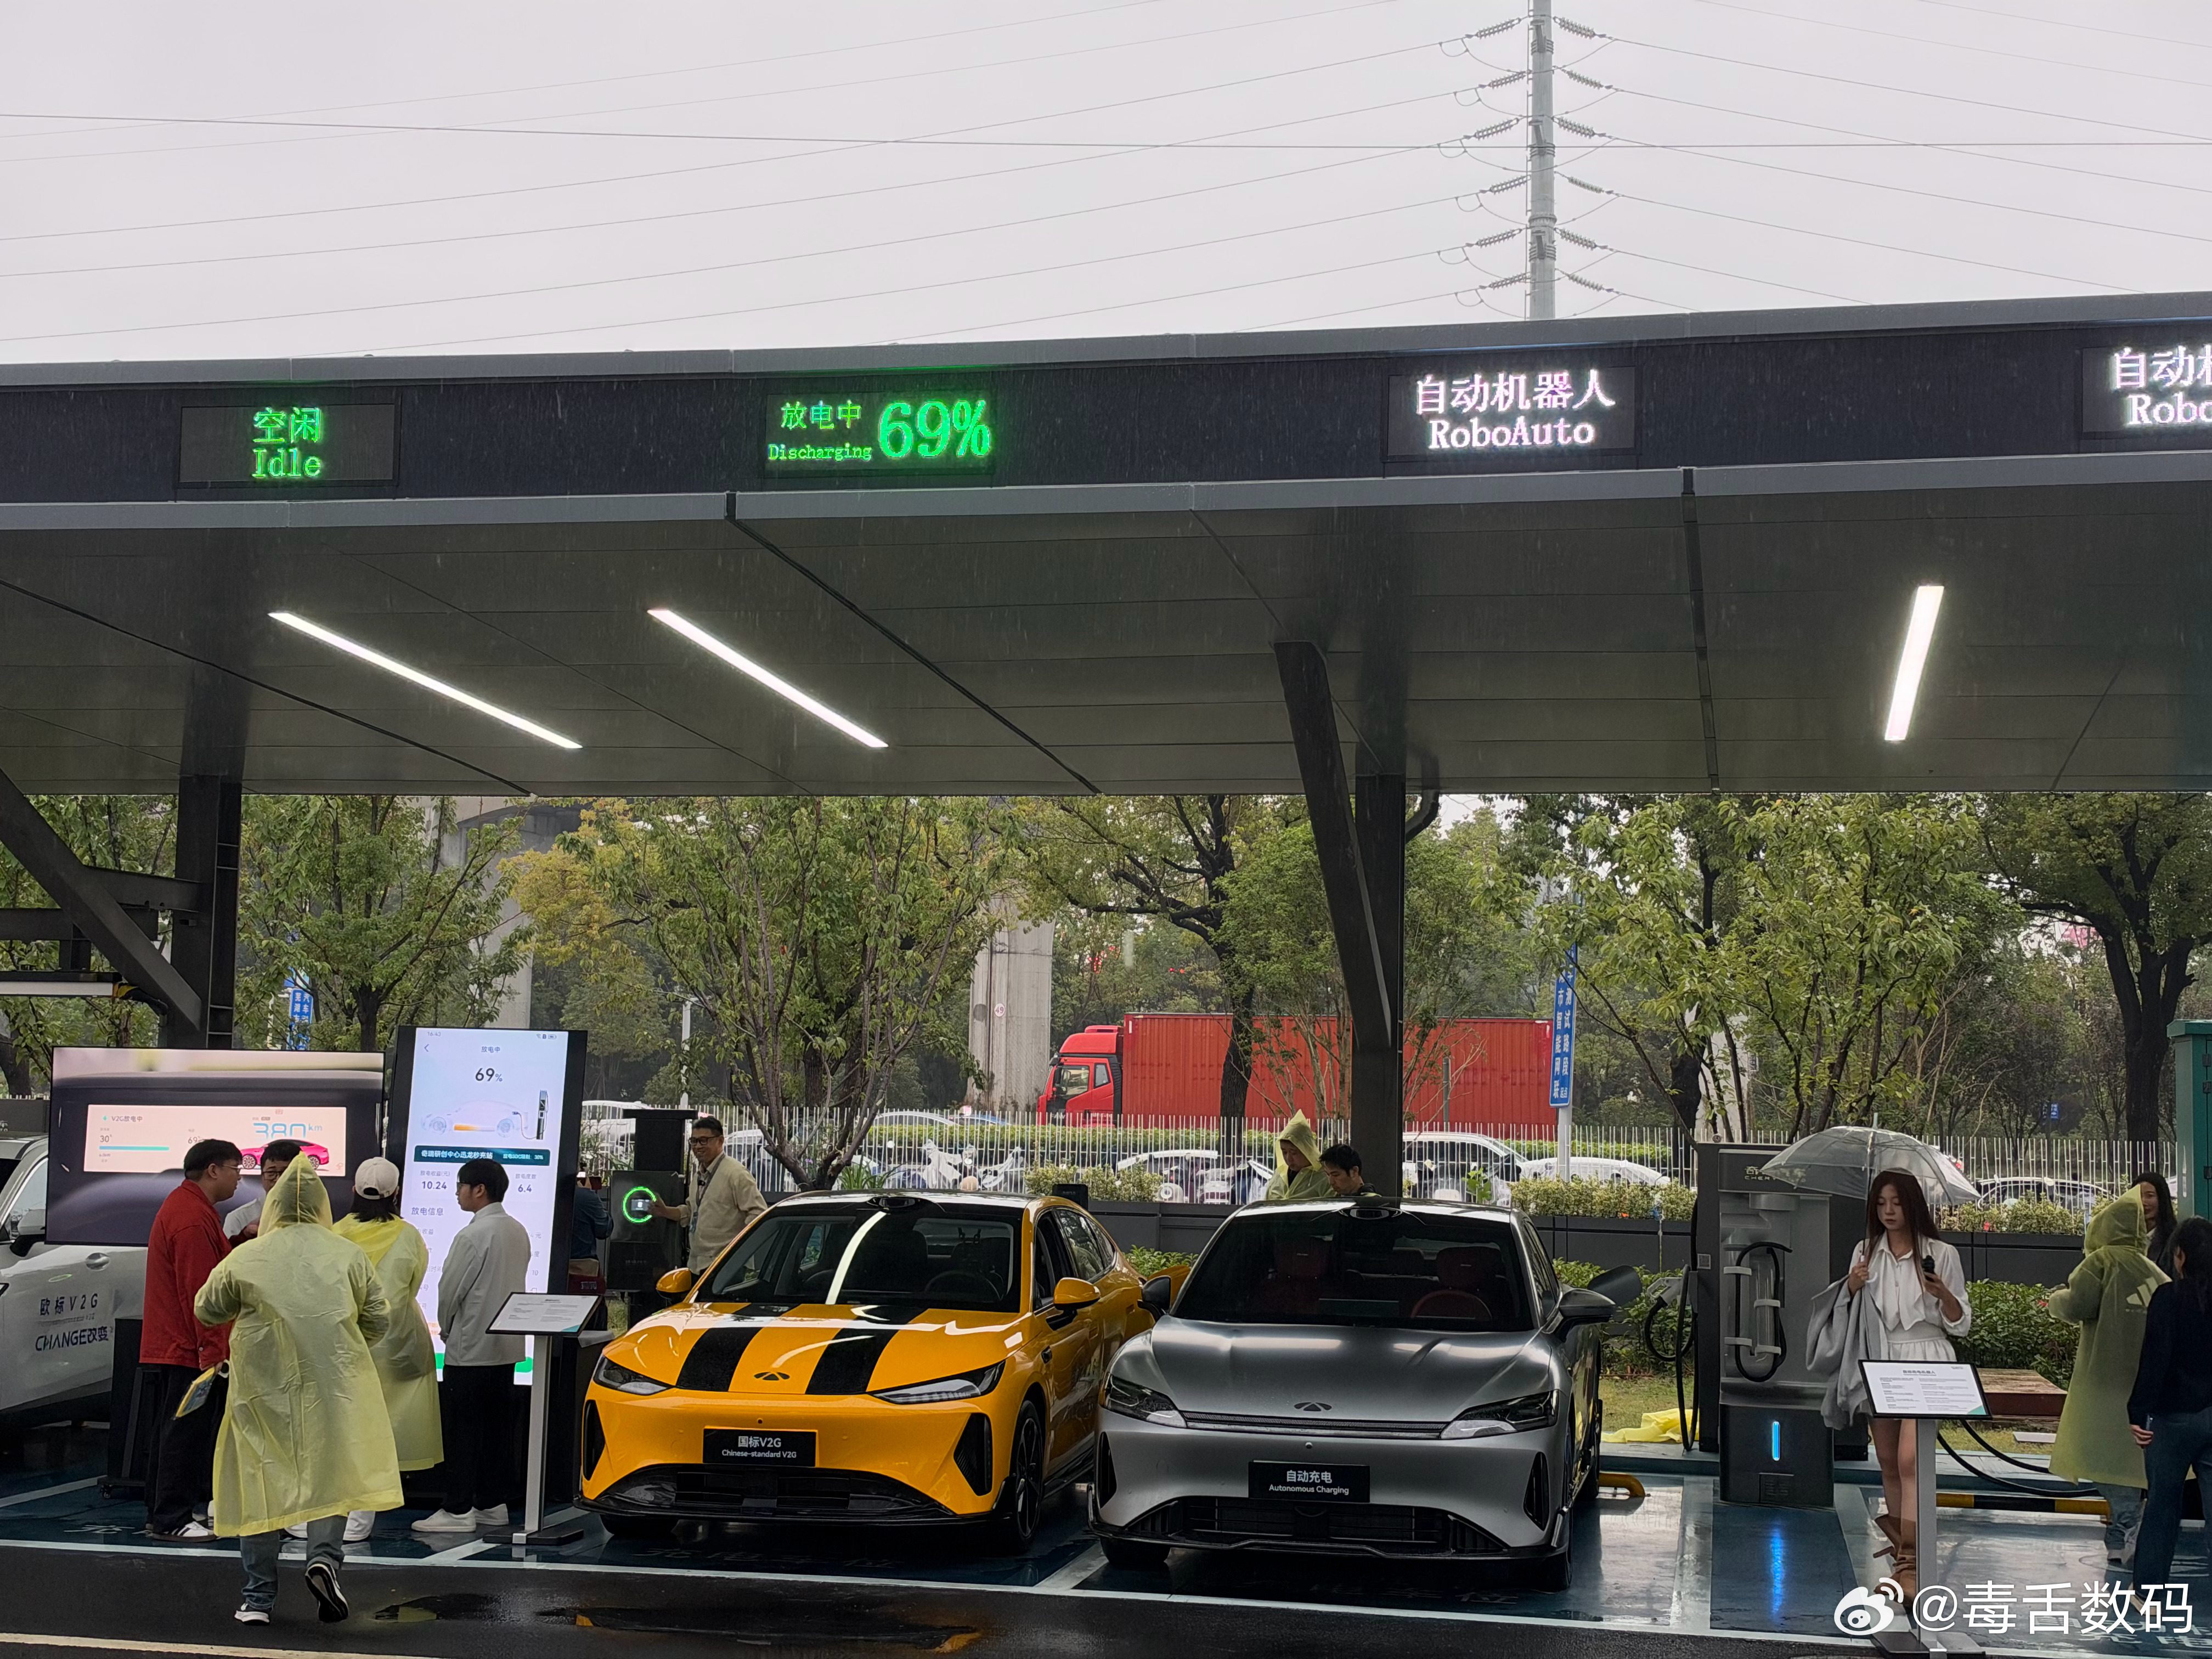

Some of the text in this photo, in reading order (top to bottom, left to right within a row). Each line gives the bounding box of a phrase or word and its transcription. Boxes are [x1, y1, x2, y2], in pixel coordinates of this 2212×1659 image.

[1416, 369, 1616, 415] 自动机器人
[781, 399, 862, 430] 放电中
[252, 407, 320, 443] 空闲
[879, 399, 991, 459] 69%
[1429, 415, 1595, 449] RoboAuto
[768, 443, 872, 461] Discharging
[252, 447, 321, 478] Idle
[475, 1068, 503, 1082] 69%
[422, 1181, 447, 1190] 10.24
[517, 1183, 532, 1193] 6.4
[411, 1207, 443, 1216] 放电信息
[738, 1436, 782, 1448] 国标V2G
[721, 1449, 781, 1458] Chinese-standard
[1286, 1470, 1333, 1483] 自动充电
[1269, 1484, 1349, 1495] Autonomous Charging
